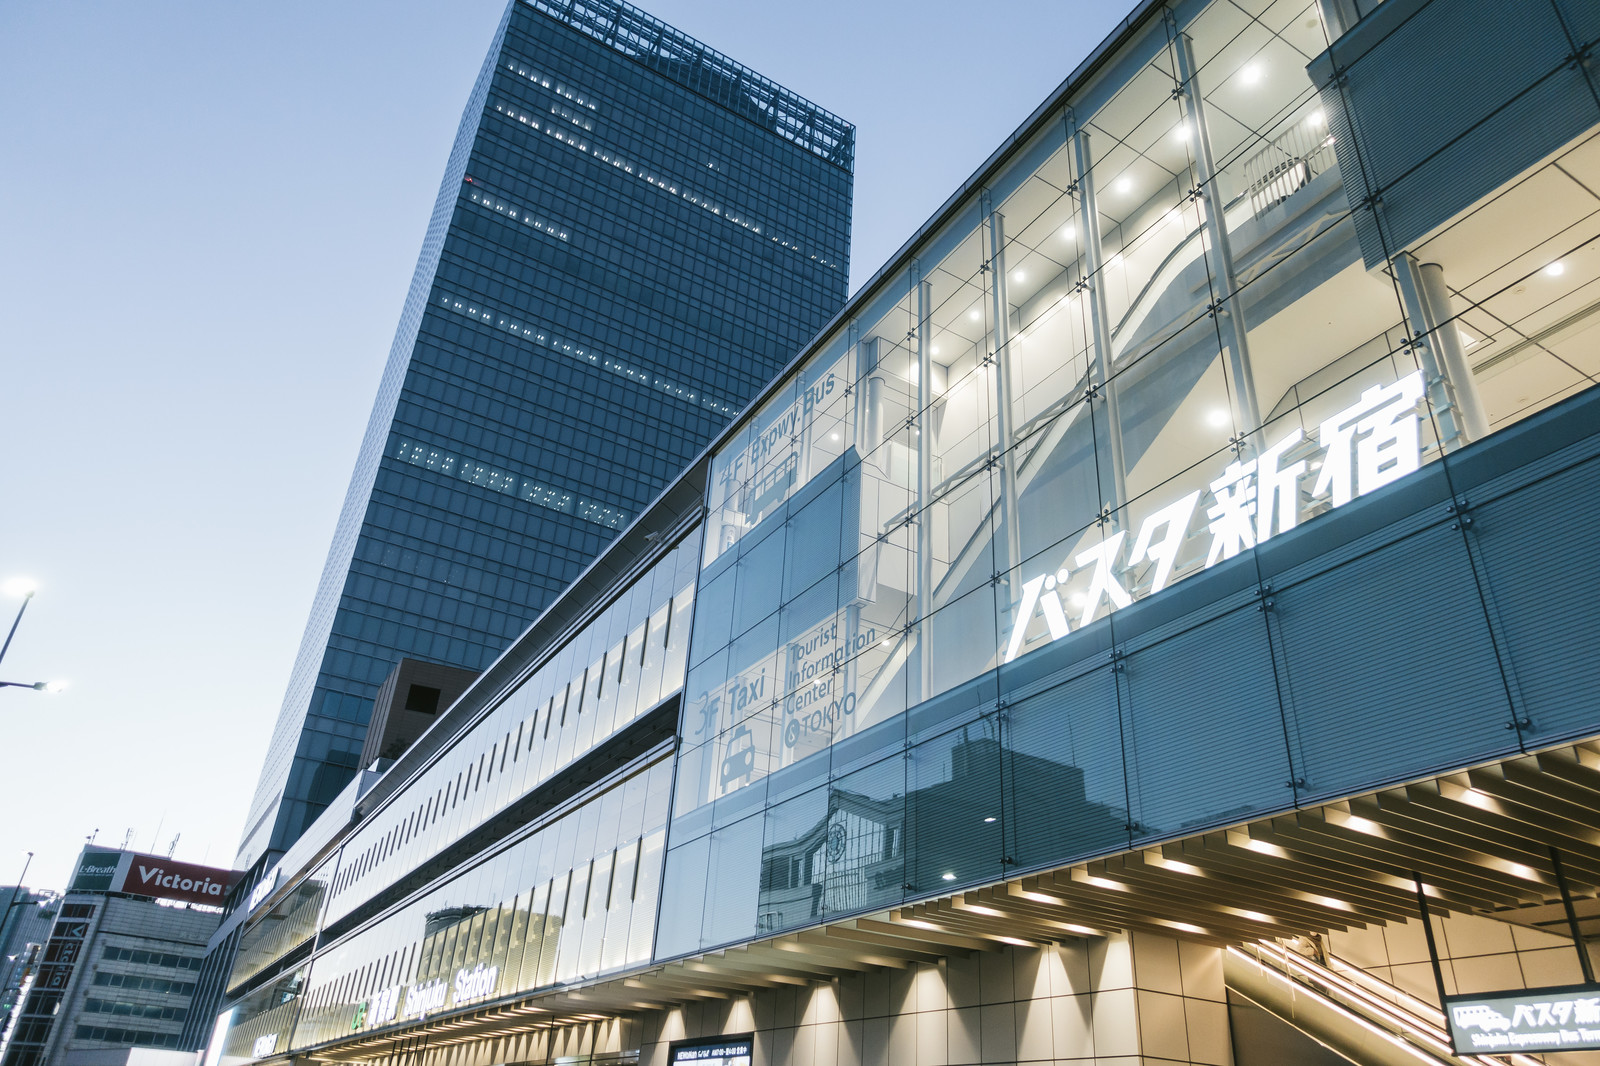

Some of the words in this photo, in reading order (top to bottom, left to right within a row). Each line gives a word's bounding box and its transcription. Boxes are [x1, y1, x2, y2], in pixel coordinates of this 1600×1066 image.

[719, 453, 745, 486] 4F
[752, 408, 801, 465] Expwy.
[803, 373, 835, 418] Bus
[1004, 369, 1426, 664] バスタ新宿
[788, 627, 876, 690] Information
[791, 622, 837, 665] Tourist
[694, 690, 721, 736] 3F
[728, 667, 766, 715] Taxi
[786, 676, 834, 715] Center
[138, 865, 222, 896] Victoria
[404, 978, 449, 1021] Shinjuku
[454, 962, 500, 1002] Station
